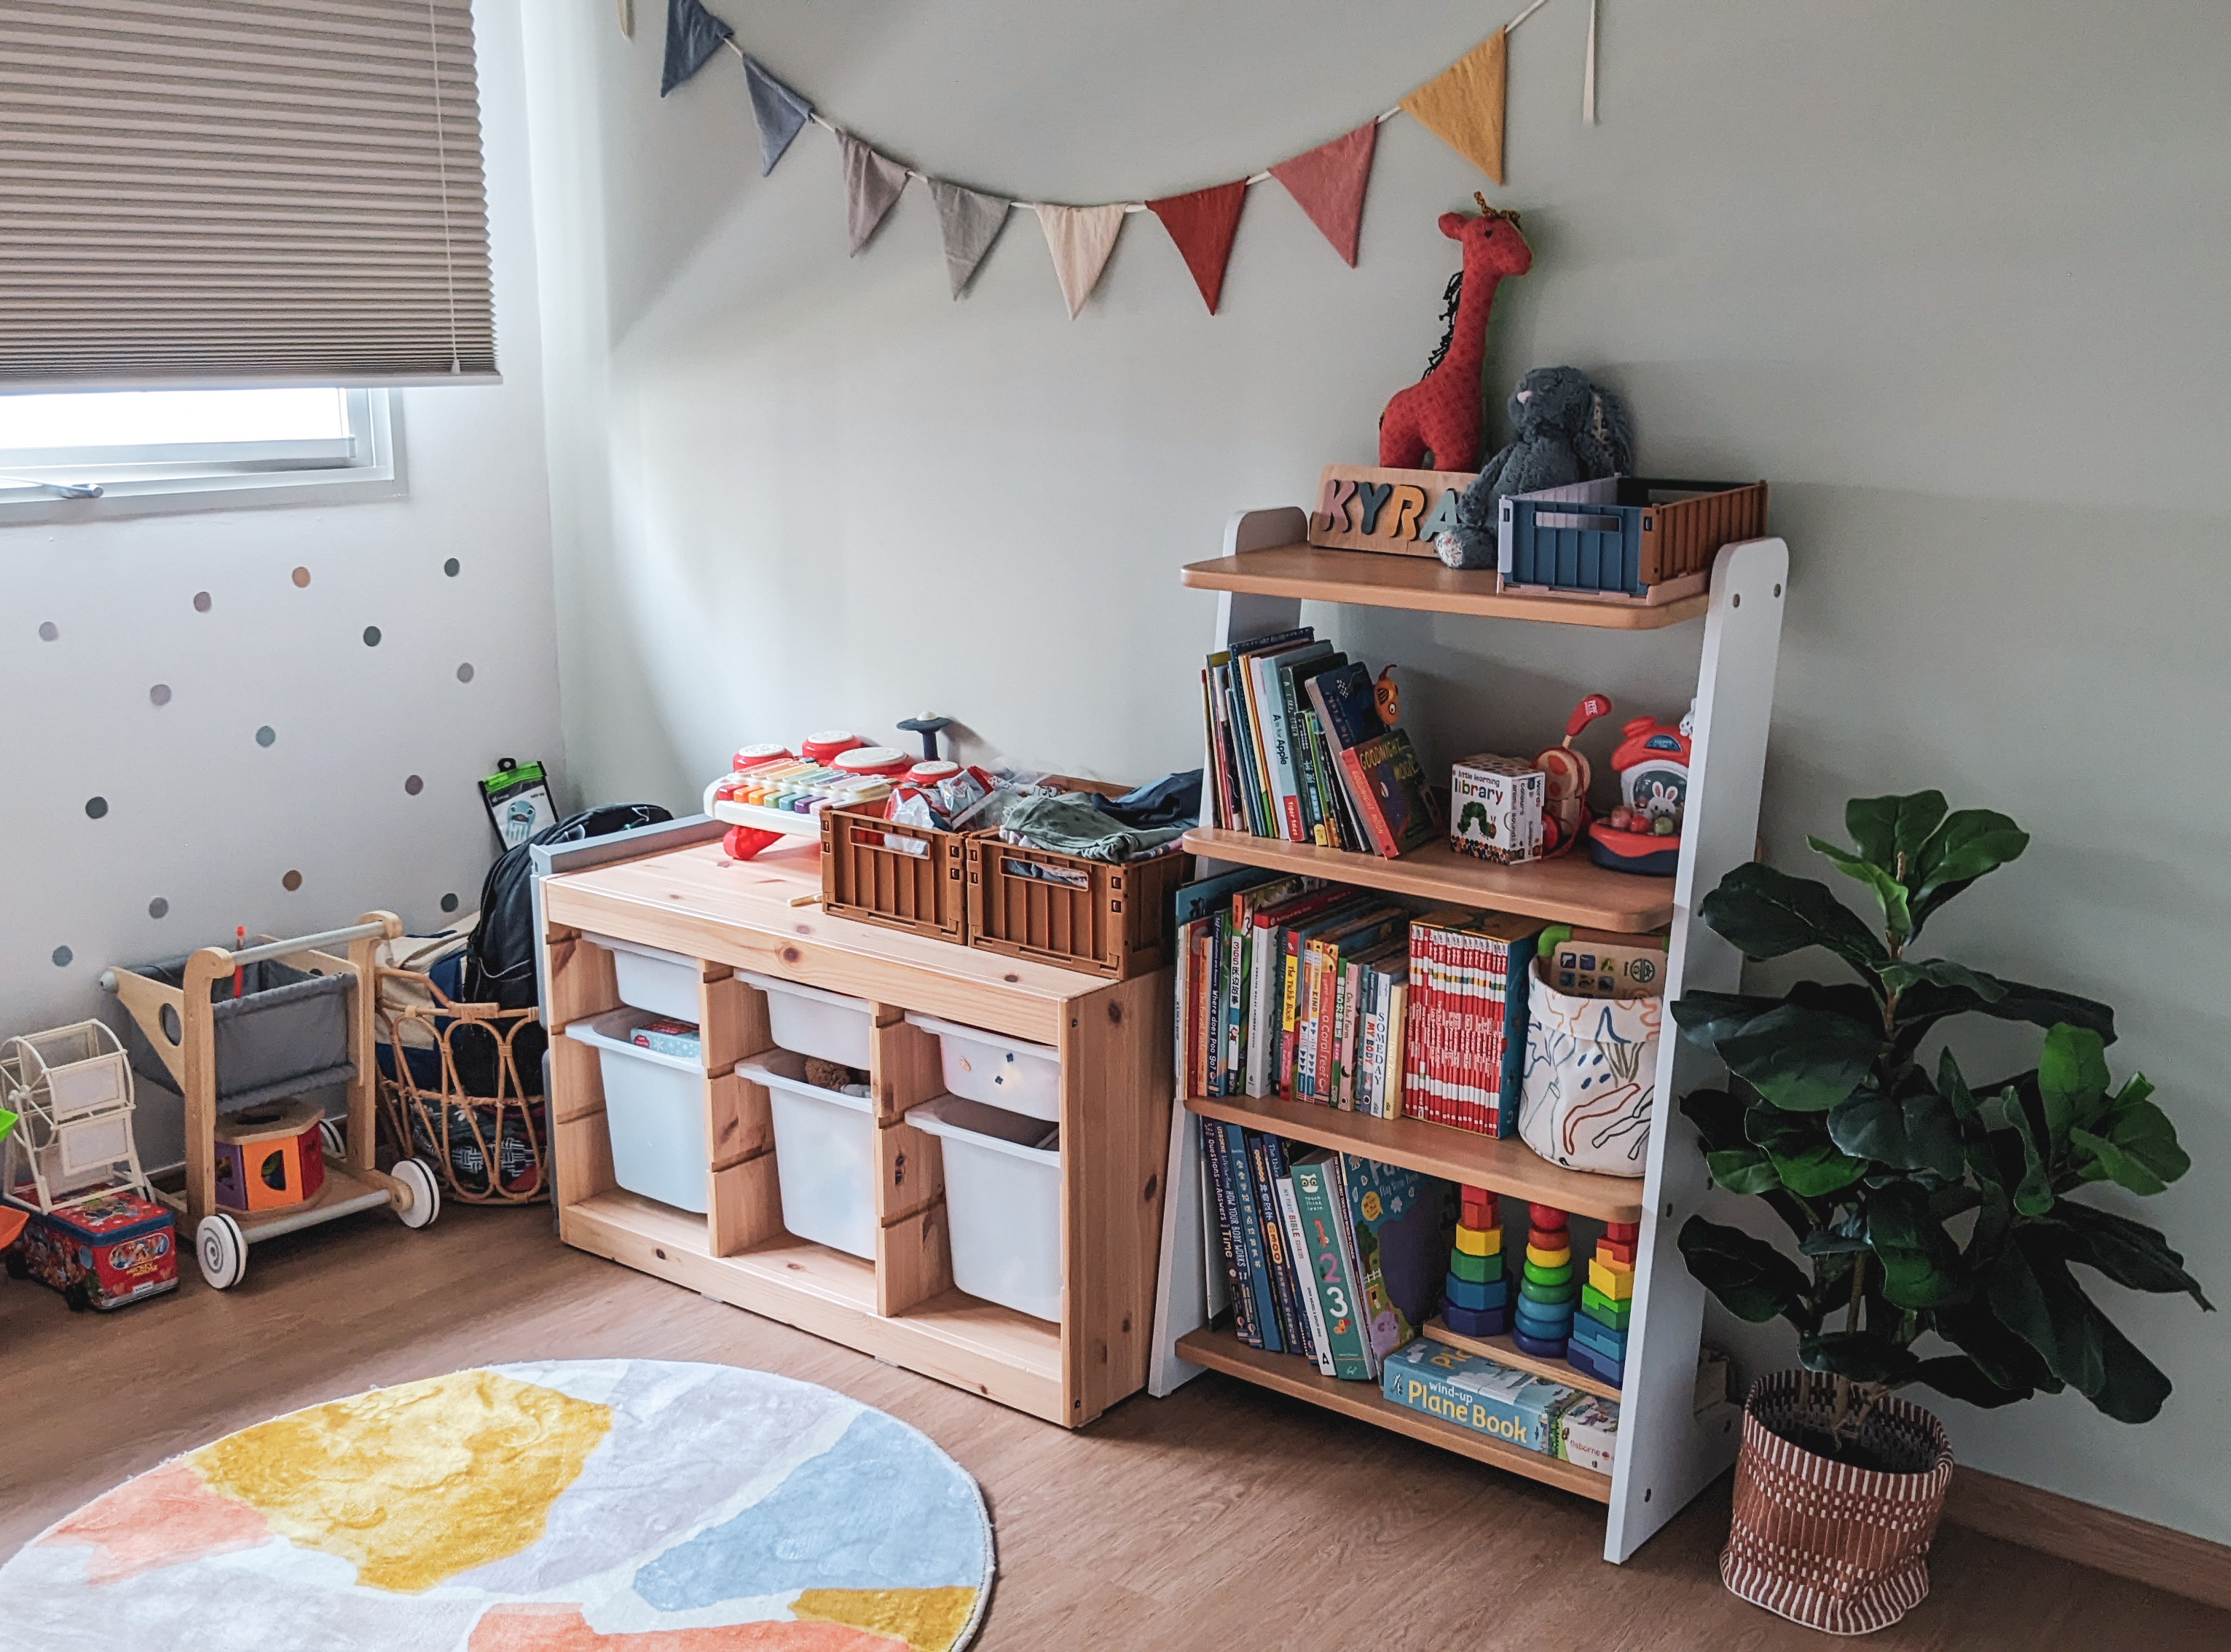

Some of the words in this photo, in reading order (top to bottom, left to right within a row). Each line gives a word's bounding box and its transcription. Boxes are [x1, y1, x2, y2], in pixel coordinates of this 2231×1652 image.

[1322, 479, 1463, 542] KYRA
[1275, 739, 1289, 766] Apple
[1458, 770, 1473, 781] little
[1473, 774, 1500, 788] learning
[1454, 777, 1503, 806] library
[1311, 991, 1319, 1012] KIND
[1346, 992, 1353, 1003] On
[1286, 1003, 1294, 1021] Book
[1345, 1005, 1353, 1018] the
[1321, 1025, 1330, 1053] Coral
[1344, 1020, 1353, 1039] Farm
[1366, 1021, 1375, 1037] MY
[1365, 1039, 1375, 1065] BODY
[1374, 1012, 1385, 1085] SOMEDAY
[1388, 1042, 1396, 1061] Dear
[1320, 1055, 1330, 1078] reef
[1216, 1126, 1227, 1154] USBORNE
[1268, 1143, 1277, 1157] The
[1215, 1187, 1228, 1221] Answers
[1225, 1189, 1236, 1206] HOW
[1228, 1207, 1240, 1225] YOUR
[1288, 1214, 1301, 1238] BIBLE
[1221, 1230, 1235, 1259] Time
[1231, 1225, 1243, 1244] BODY
[1234, 1244, 1246, 1268] WORKS
[1319, 1253, 1341, 1283] 2
[1326, 1286, 1348, 1318] 3
[1429, 1381, 1473, 1406] wind-up
[1408, 1380, 1468, 1423] Plane
[1472, 1404, 1527, 1444] Book
